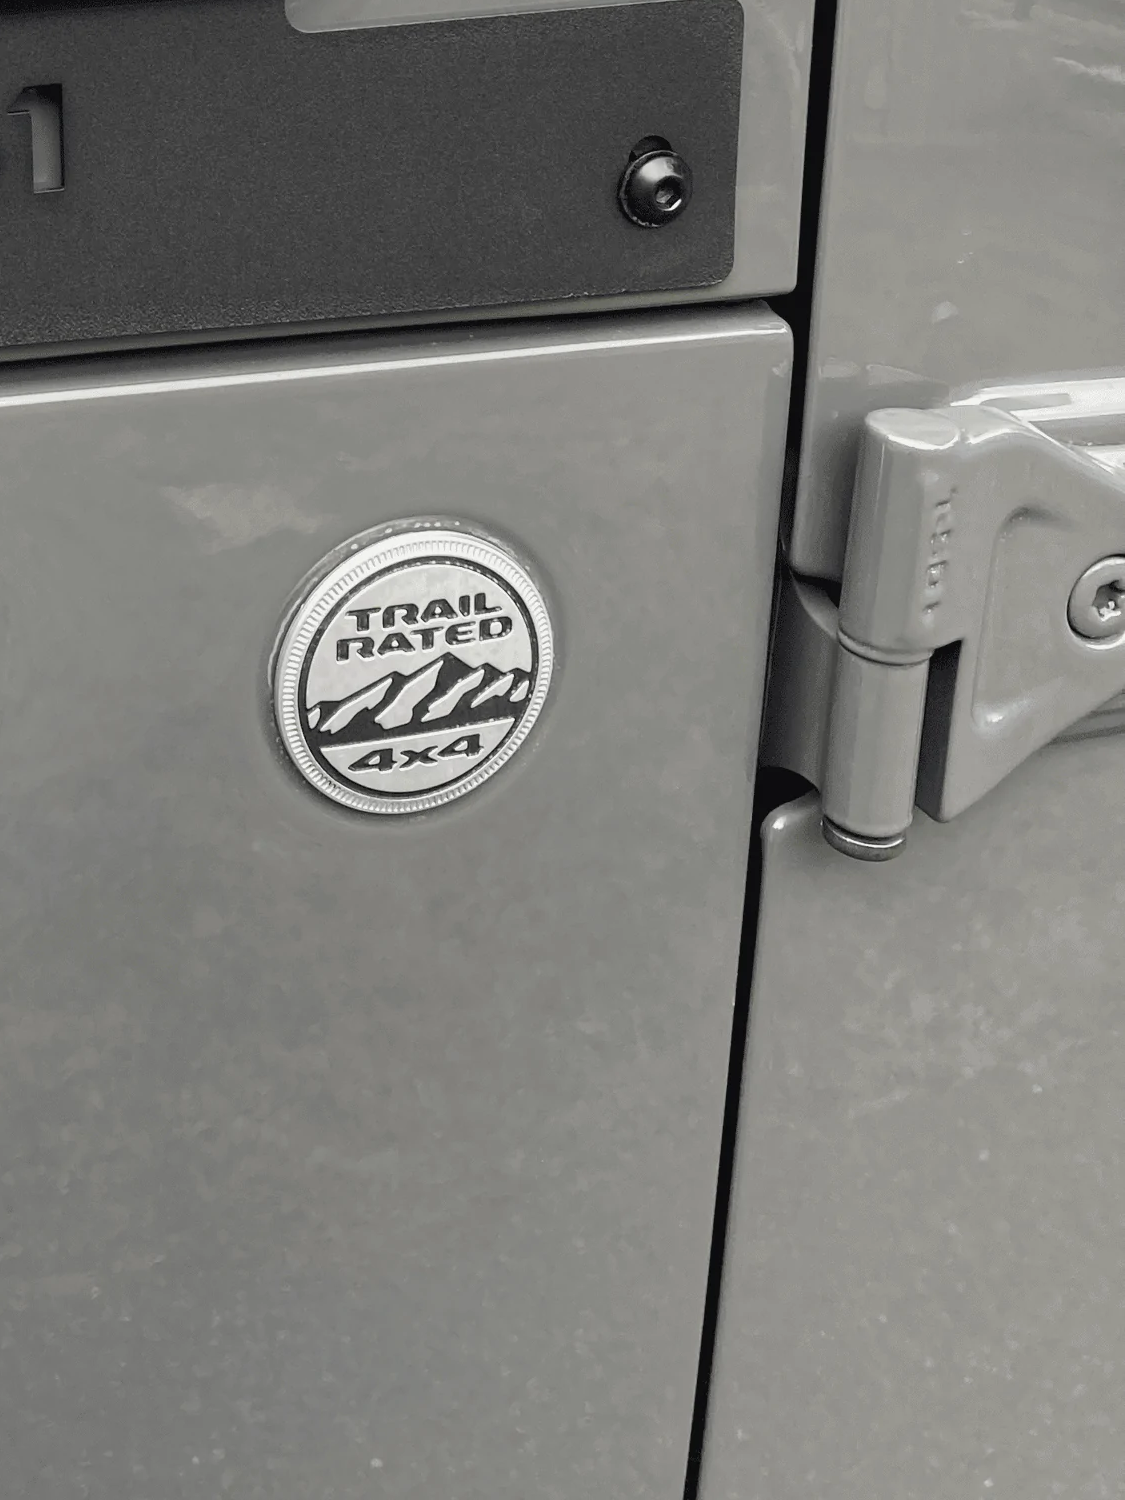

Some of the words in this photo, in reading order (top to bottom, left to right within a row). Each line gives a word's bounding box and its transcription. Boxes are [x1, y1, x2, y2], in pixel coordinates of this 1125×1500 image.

[346, 592, 503, 632] TRAIL
[335, 615, 513, 663] RATED
[347, 733, 484, 773] 4x4
